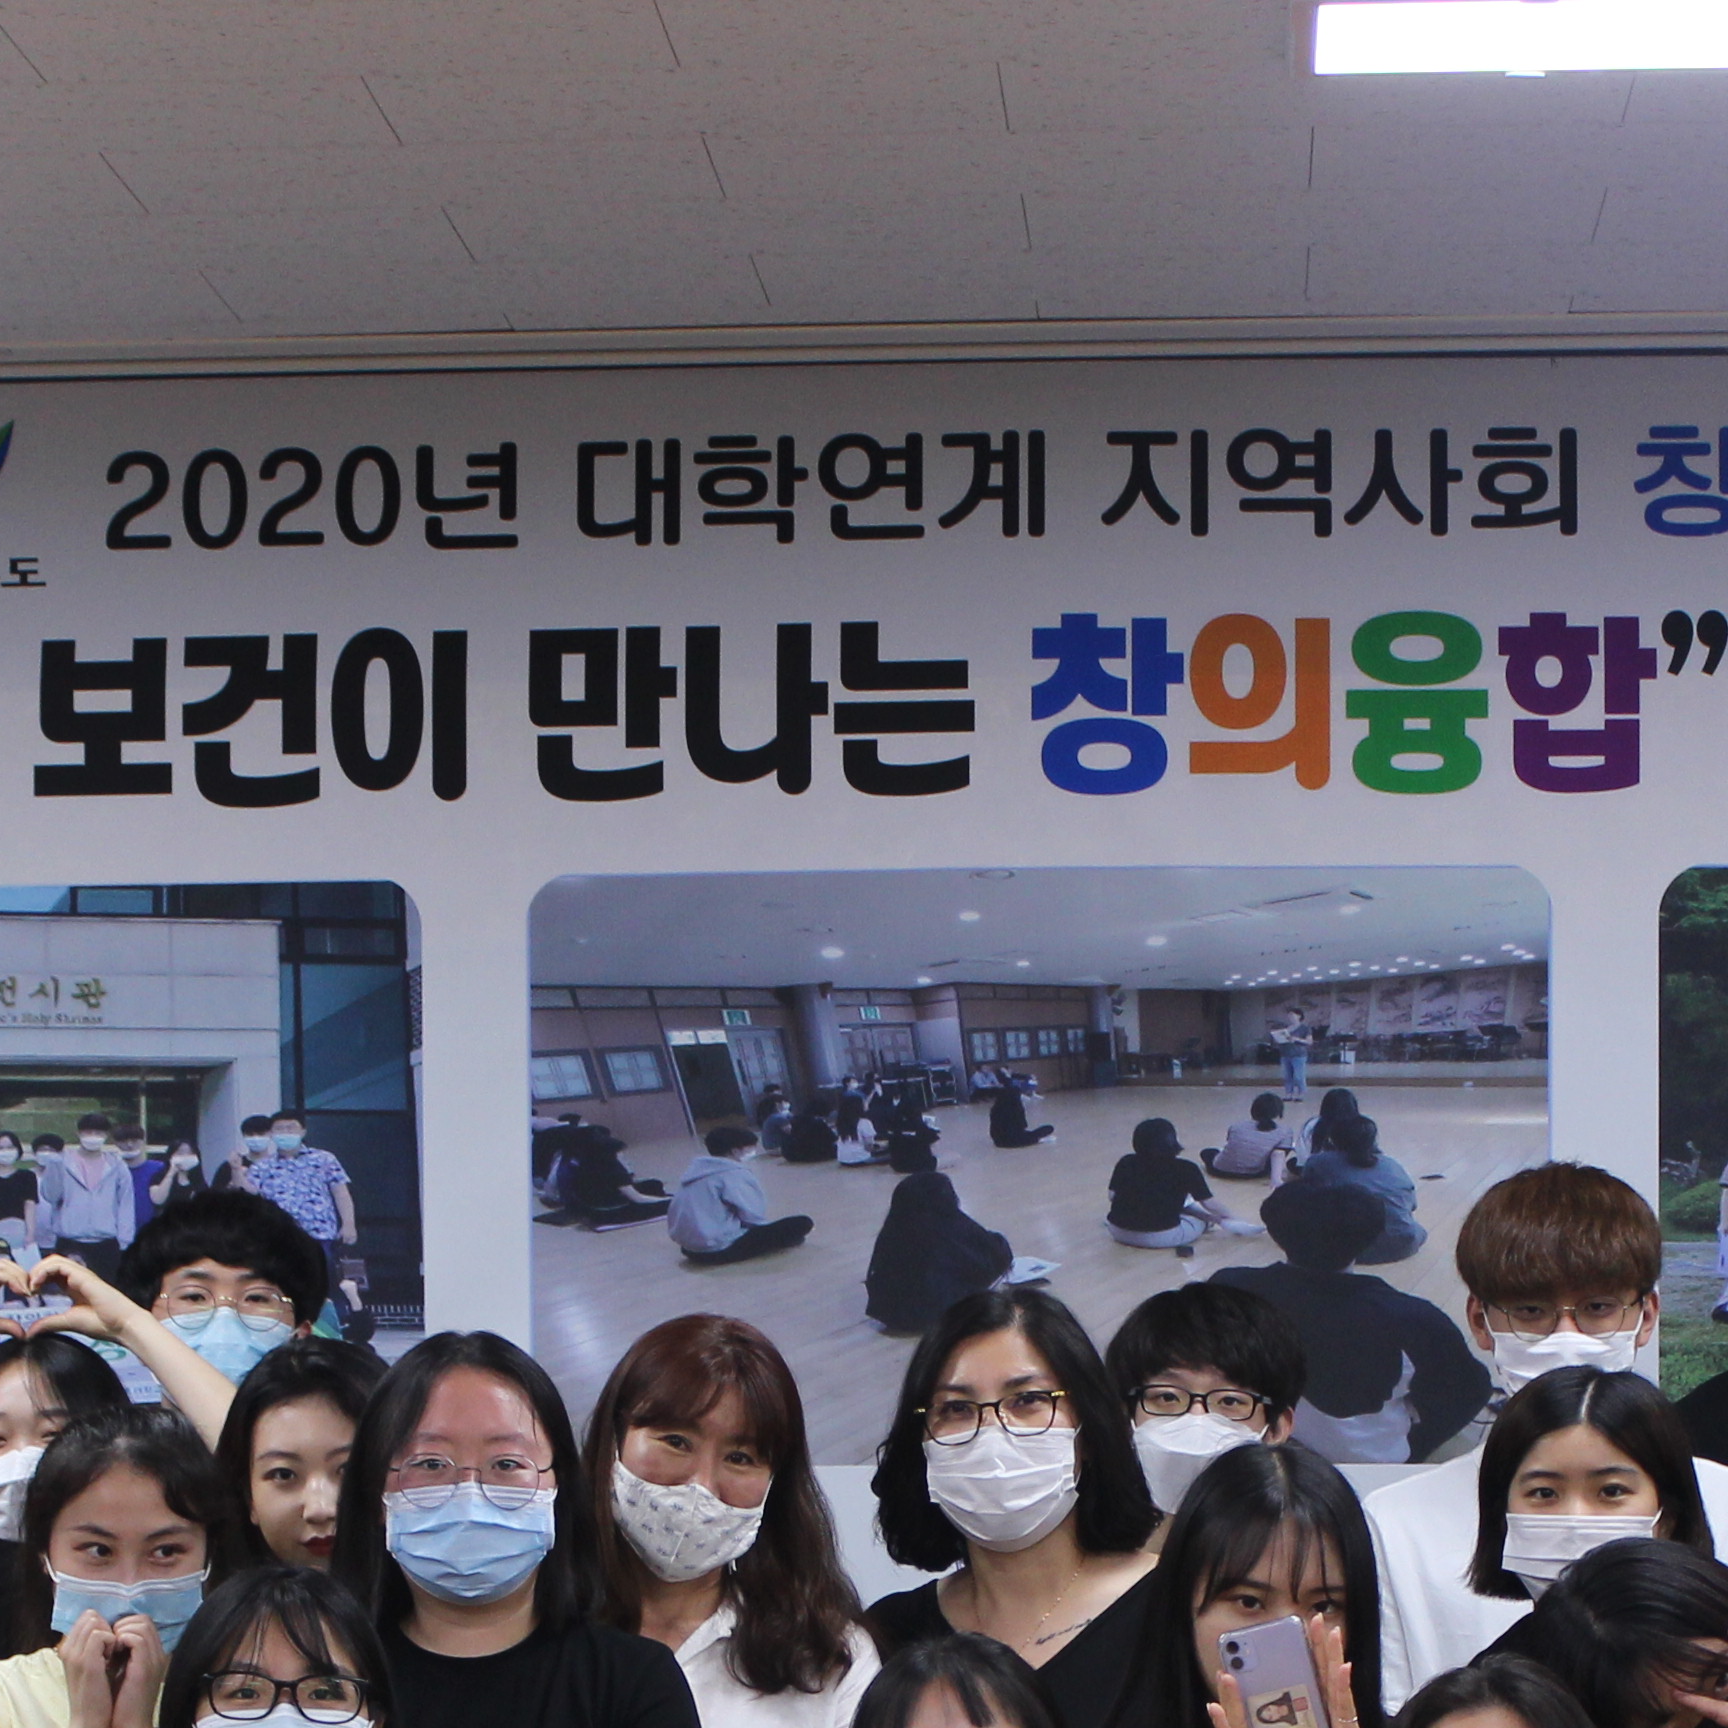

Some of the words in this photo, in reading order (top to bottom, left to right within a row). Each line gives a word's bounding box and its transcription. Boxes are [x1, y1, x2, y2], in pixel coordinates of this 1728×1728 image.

[105, 441, 519, 551] 2020년
[576, 428, 1046, 547] 대학연계
[1100, 426, 1578, 538] 지역사회
[33, 626, 469, 809] 보건이
[528, 620, 976, 803] 만나는
